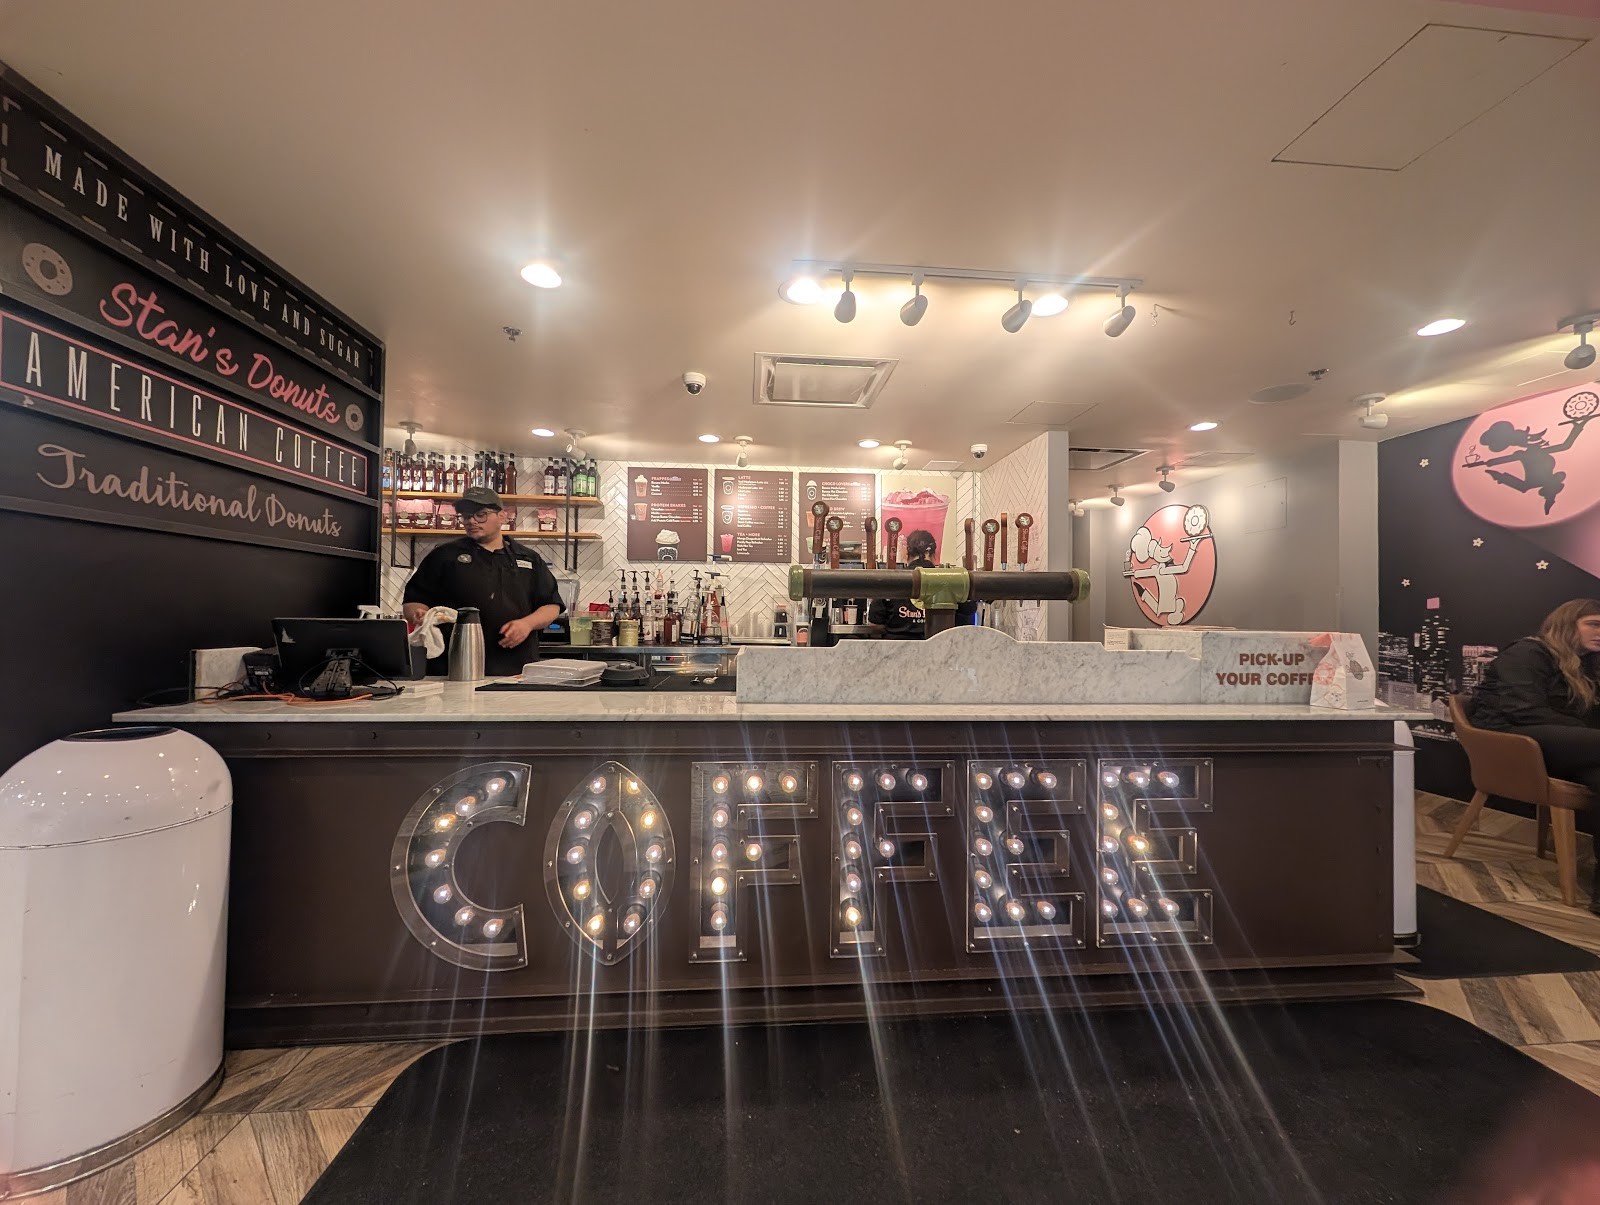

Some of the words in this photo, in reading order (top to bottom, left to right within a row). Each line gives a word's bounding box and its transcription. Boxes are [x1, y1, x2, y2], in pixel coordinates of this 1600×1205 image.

[44, 145, 129, 222] MADE
[149, 214, 210, 274] WITH
[225, 265, 271, 311] LOVE
[281, 303, 311, 336] AND
[320, 328, 360, 369] SUGAR
[25, 331, 248, 452] AMERICAN
[275, 427, 358, 487] COFFEE
[100, 283, 239, 376] Stan's
[247, 353, 341, 425] Donuts
[37, 443, 261, 523] Traditional
[266, 493, 342, 538] Donuts
[898, 606, 921, 618] Stan's
[1239, 653, 1305, 667] PICK-UP
[1216, 672, 1262, 686] YOUR
[389, 757, 1214, 972] COFFEE
